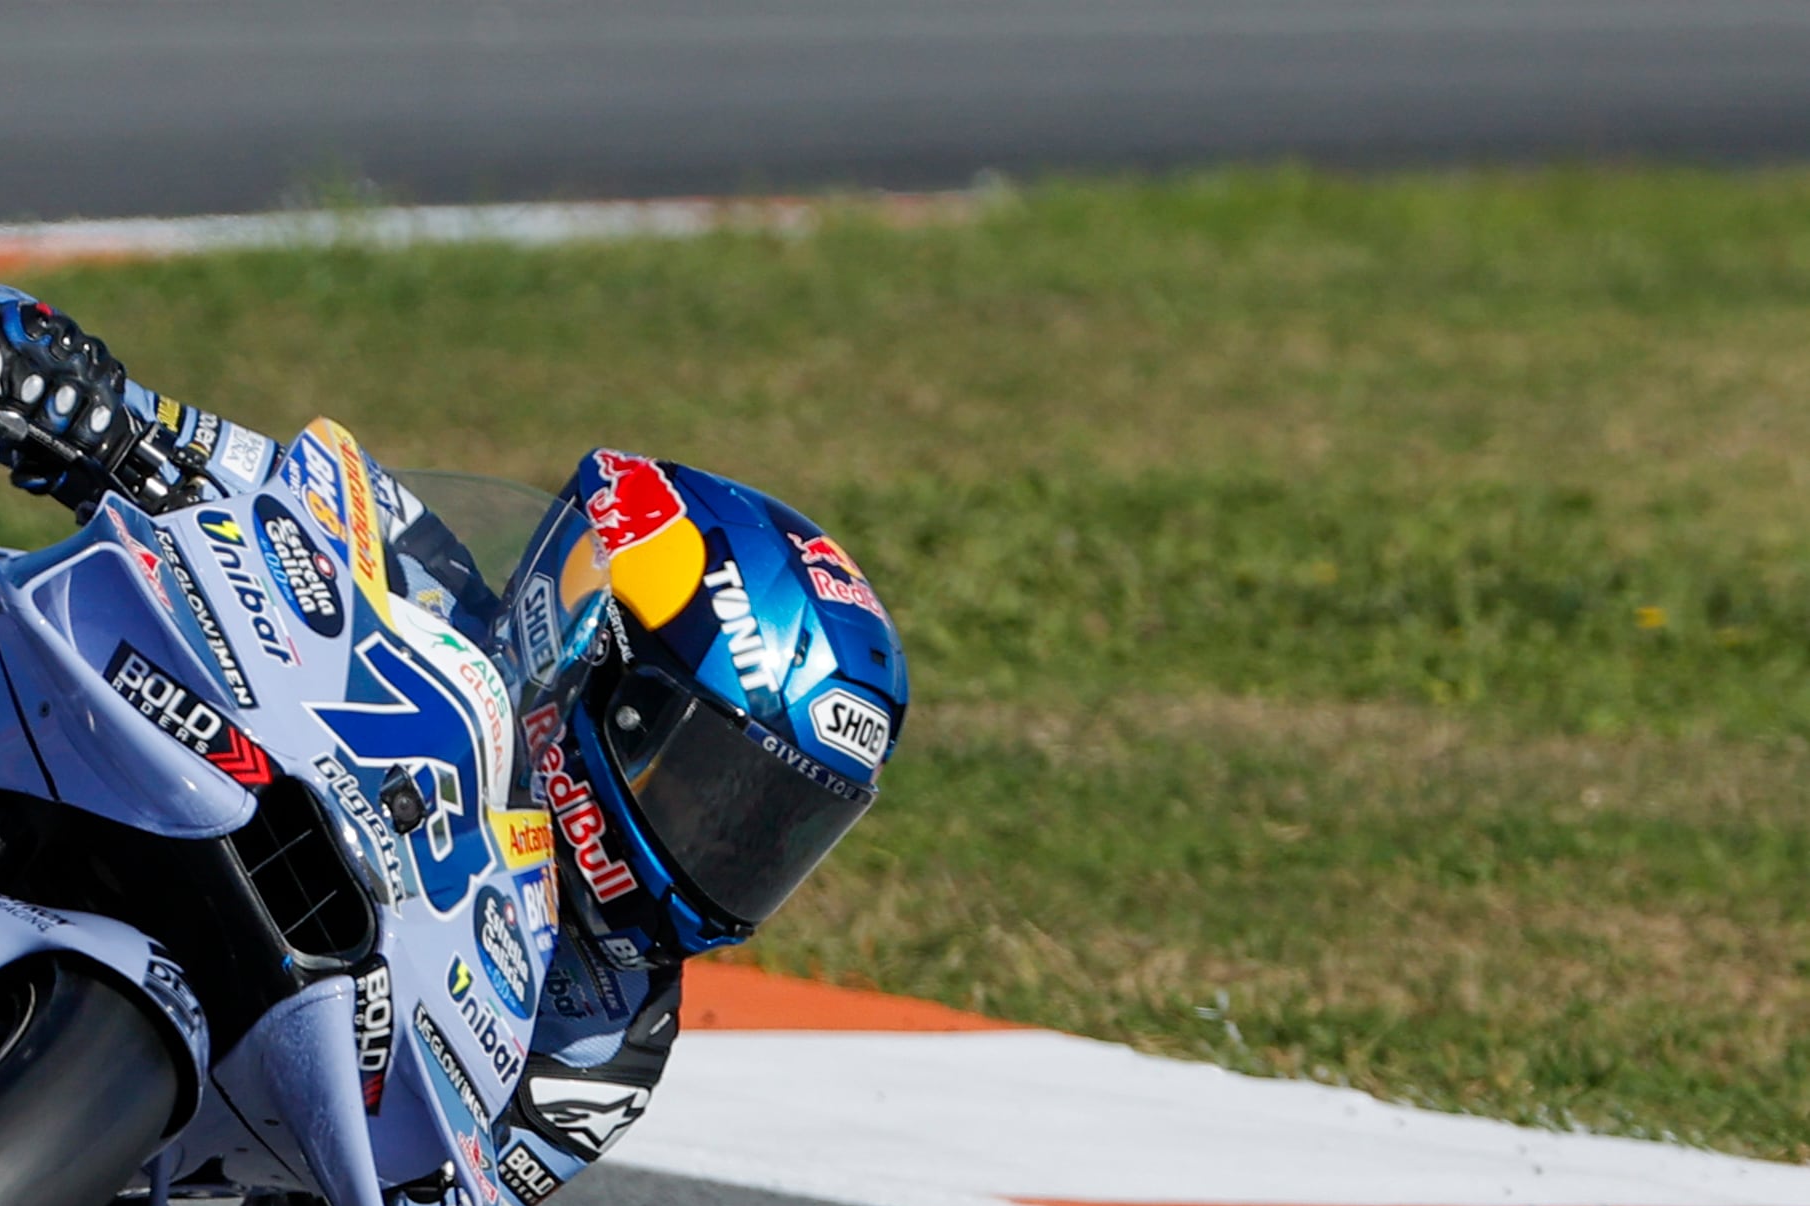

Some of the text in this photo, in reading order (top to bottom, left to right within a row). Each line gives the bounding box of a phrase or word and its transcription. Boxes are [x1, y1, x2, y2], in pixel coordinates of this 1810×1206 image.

[195, 507, 293, 669] Unibat
[264, 519, 318, 614] Galicia
[276, 516, 336, 616] Estrella
[111, 677, 209, 755] RIDERS
[120, 652, 222, 743] BOLD
[459, 663, 504, 776] GLOBAL
[470, 659, 508, 718] AUS
[761, 734, 820, 780] GIVES
[359, 965, 392, 1073] BOLD
[447, 953, 523, 1087] Unibat
[505, 1145, 556, 1197] BOLD
